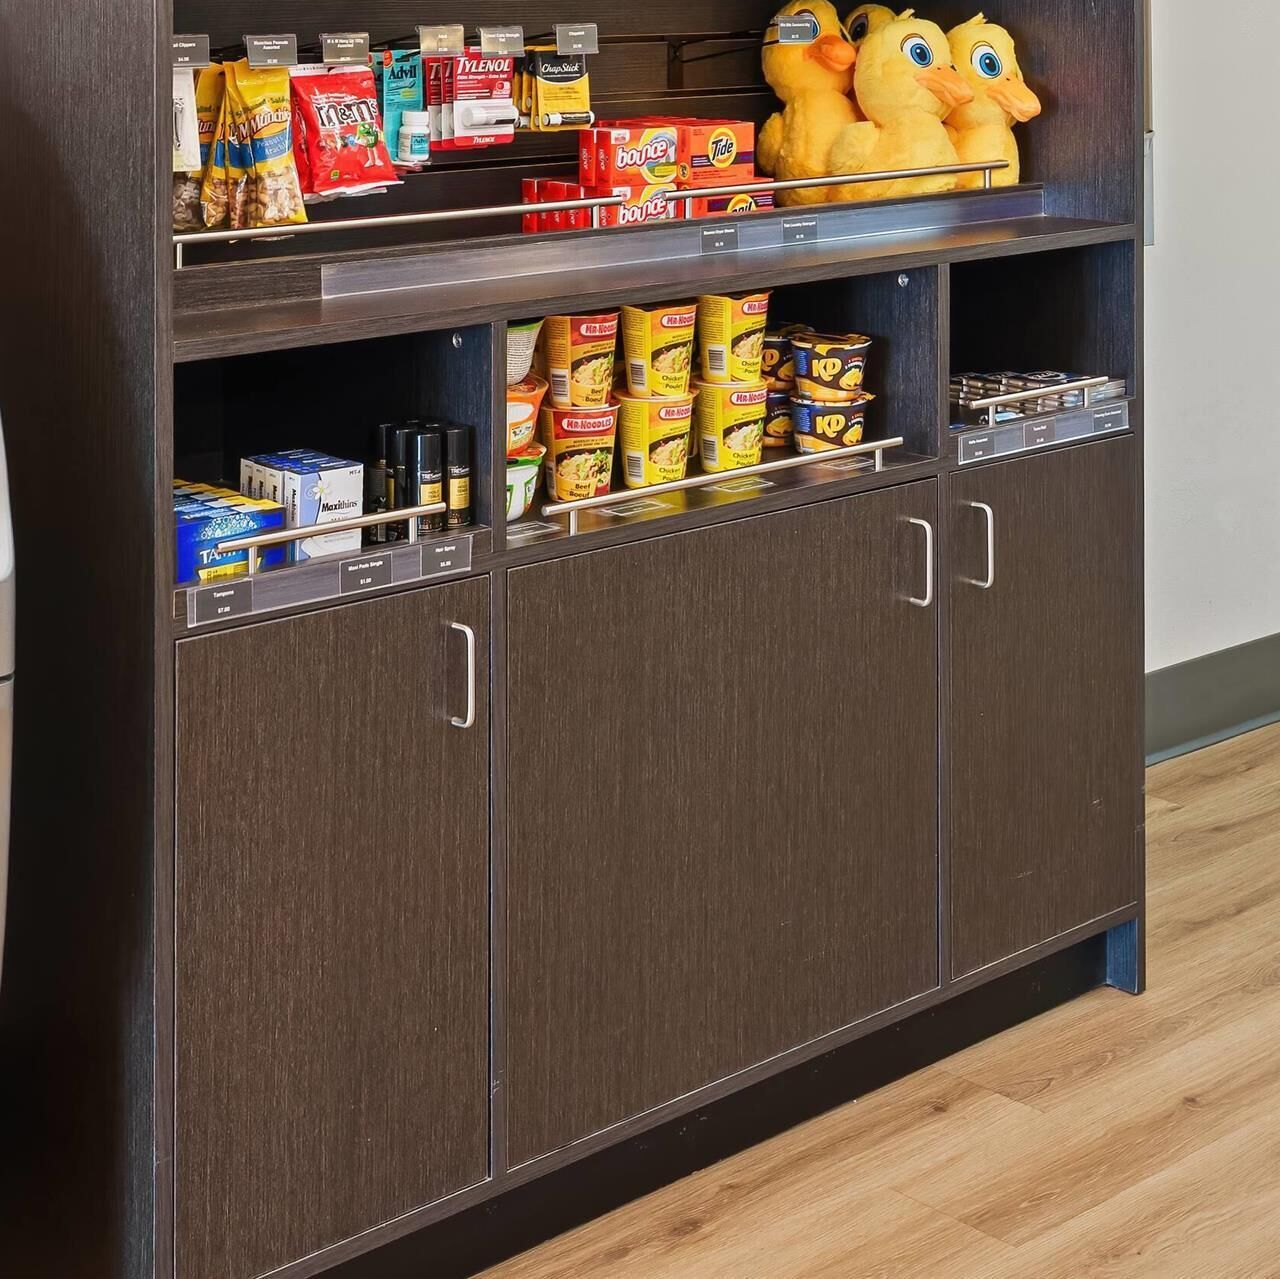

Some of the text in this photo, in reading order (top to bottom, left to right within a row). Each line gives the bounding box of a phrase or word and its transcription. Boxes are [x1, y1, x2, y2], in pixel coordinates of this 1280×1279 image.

[388, 64, 417, 81] Advil
[456, 57, 511, 74] TYLENOL
[542, 63, 580, 74] ChapStick
[616, 139, 669, 169] bounce
[711, 137, 734, 161] Tide
[618, 196, 668, 225] bounce
[812, 357, 842, 382] KD
[580, 417, 612, 430] NOODLES
[816, 414, 846, 438] KD
[321, 499, 359, 513] Maxithins
